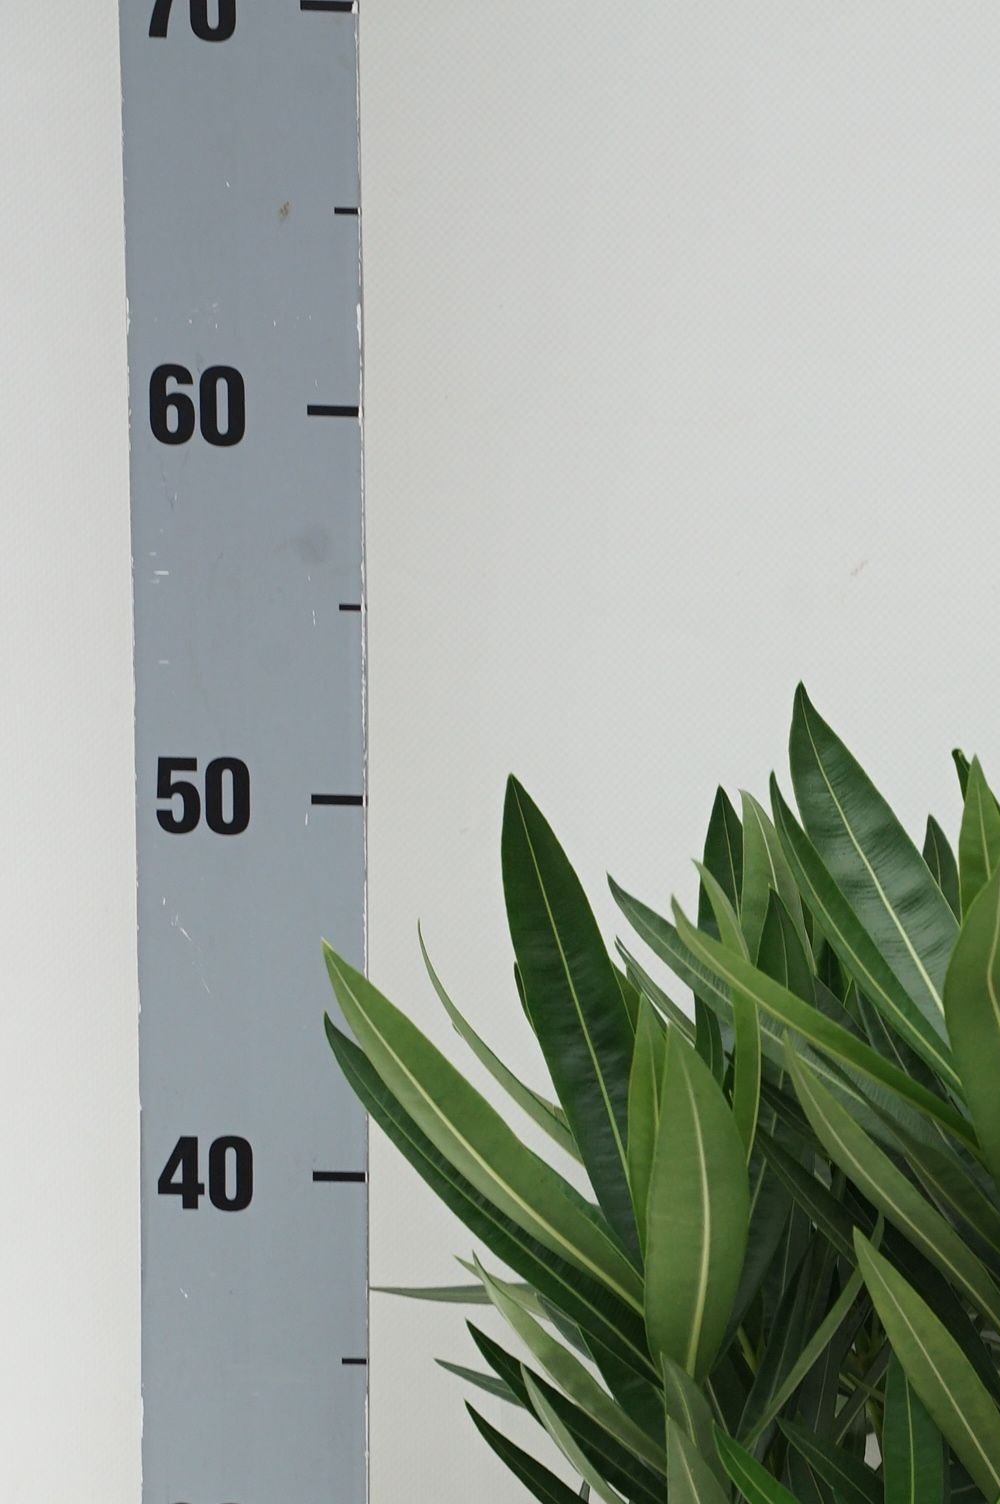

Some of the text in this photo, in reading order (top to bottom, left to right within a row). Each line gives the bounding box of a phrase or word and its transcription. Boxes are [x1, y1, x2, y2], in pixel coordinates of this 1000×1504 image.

[149, 363, 246, 447] 60
[156, 756, 251, 836] 50
[157, 1135, 254, 1212] 40
